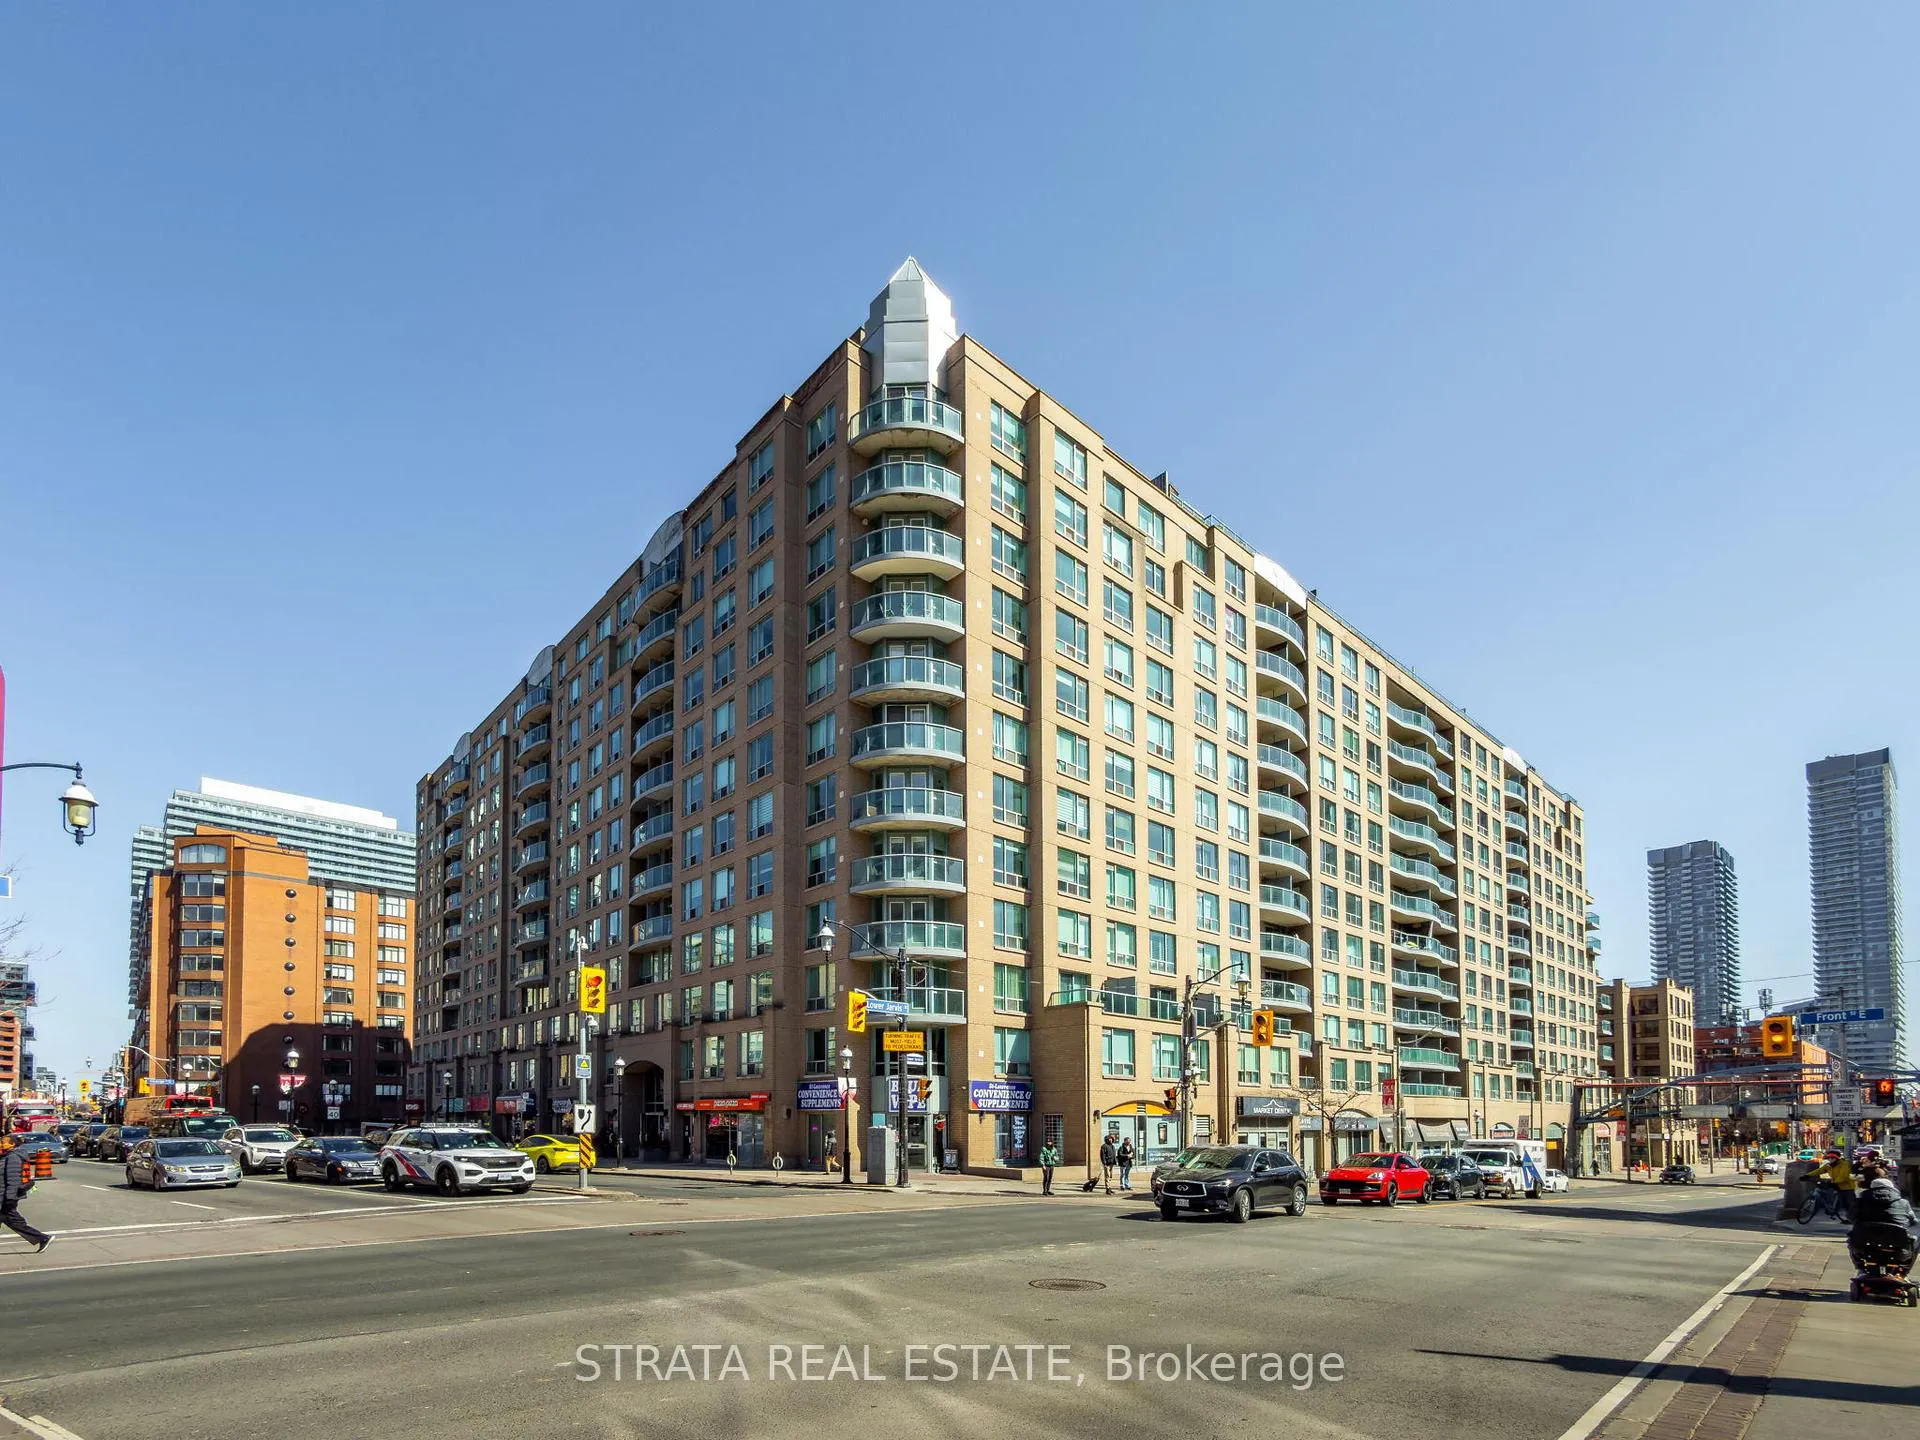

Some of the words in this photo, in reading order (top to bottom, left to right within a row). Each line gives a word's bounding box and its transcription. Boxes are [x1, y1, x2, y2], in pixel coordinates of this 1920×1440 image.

[866, 1002, 884, 1010] Lower
[887, 1003, 903, 1012] Jarvis
[1816, 1011, 1847, 1022] Front
[1859, 1010, 1867, 1019] E
[797, 1089, 838, 1099] CONVENIENCE
[973, 1088, 1024, 1100] CONVENIENCE
[1025, 1091, 1032, 1100] &
[800, 1098, 842, 1108] SUPPLEMENTS
[977, 1098, 1029, 1109] SUPPLEMENTS
